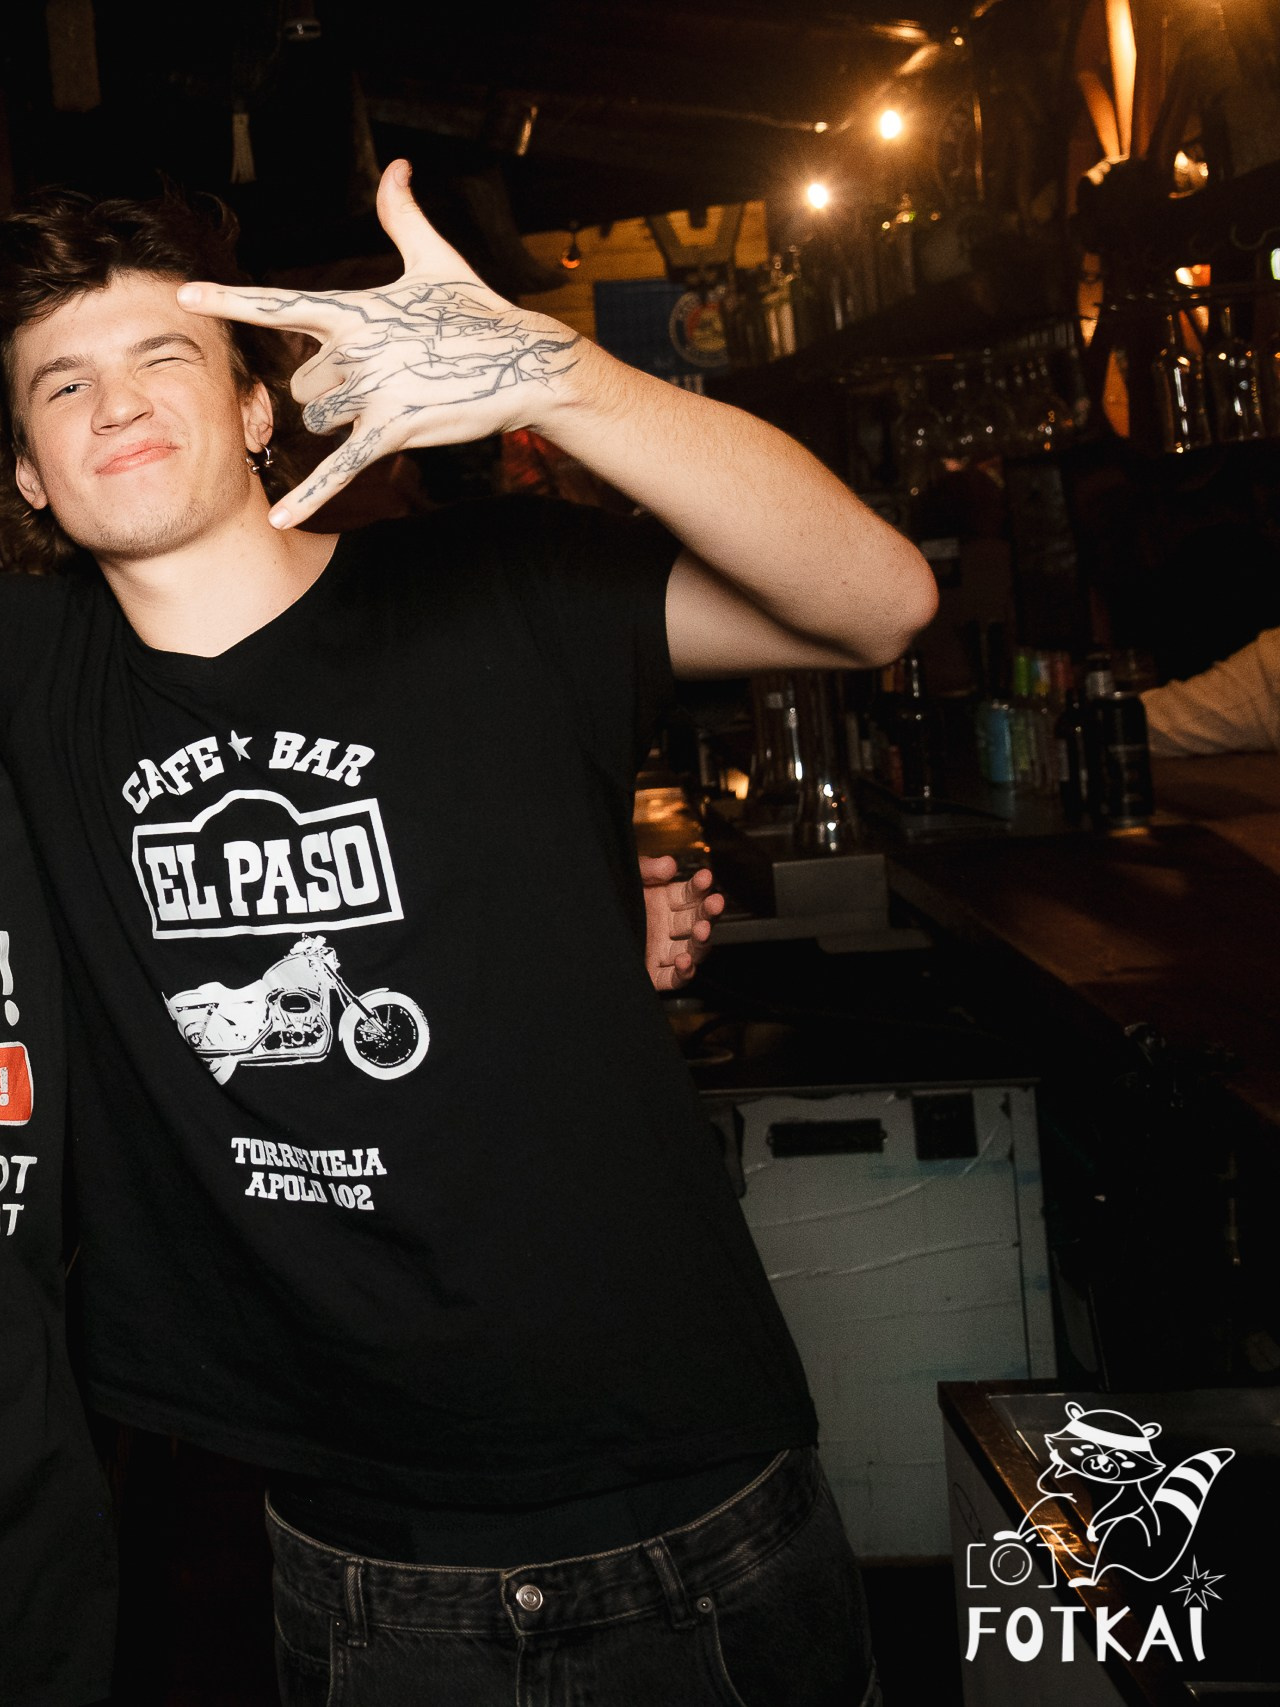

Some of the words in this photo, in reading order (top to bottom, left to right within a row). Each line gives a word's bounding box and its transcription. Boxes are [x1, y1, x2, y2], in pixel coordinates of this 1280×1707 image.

[121, 735, 225, 814] CAFE
[269, 730, 375, 787] BAR
[144, 842, 222, 922] EL
[223, 825, 380, 917] PASO
[230, 1137, 388, 1177] TORREVIEJA
[244, 1171, 328, 1204] APOLO
[329, 1182, 376, 1212] 102
